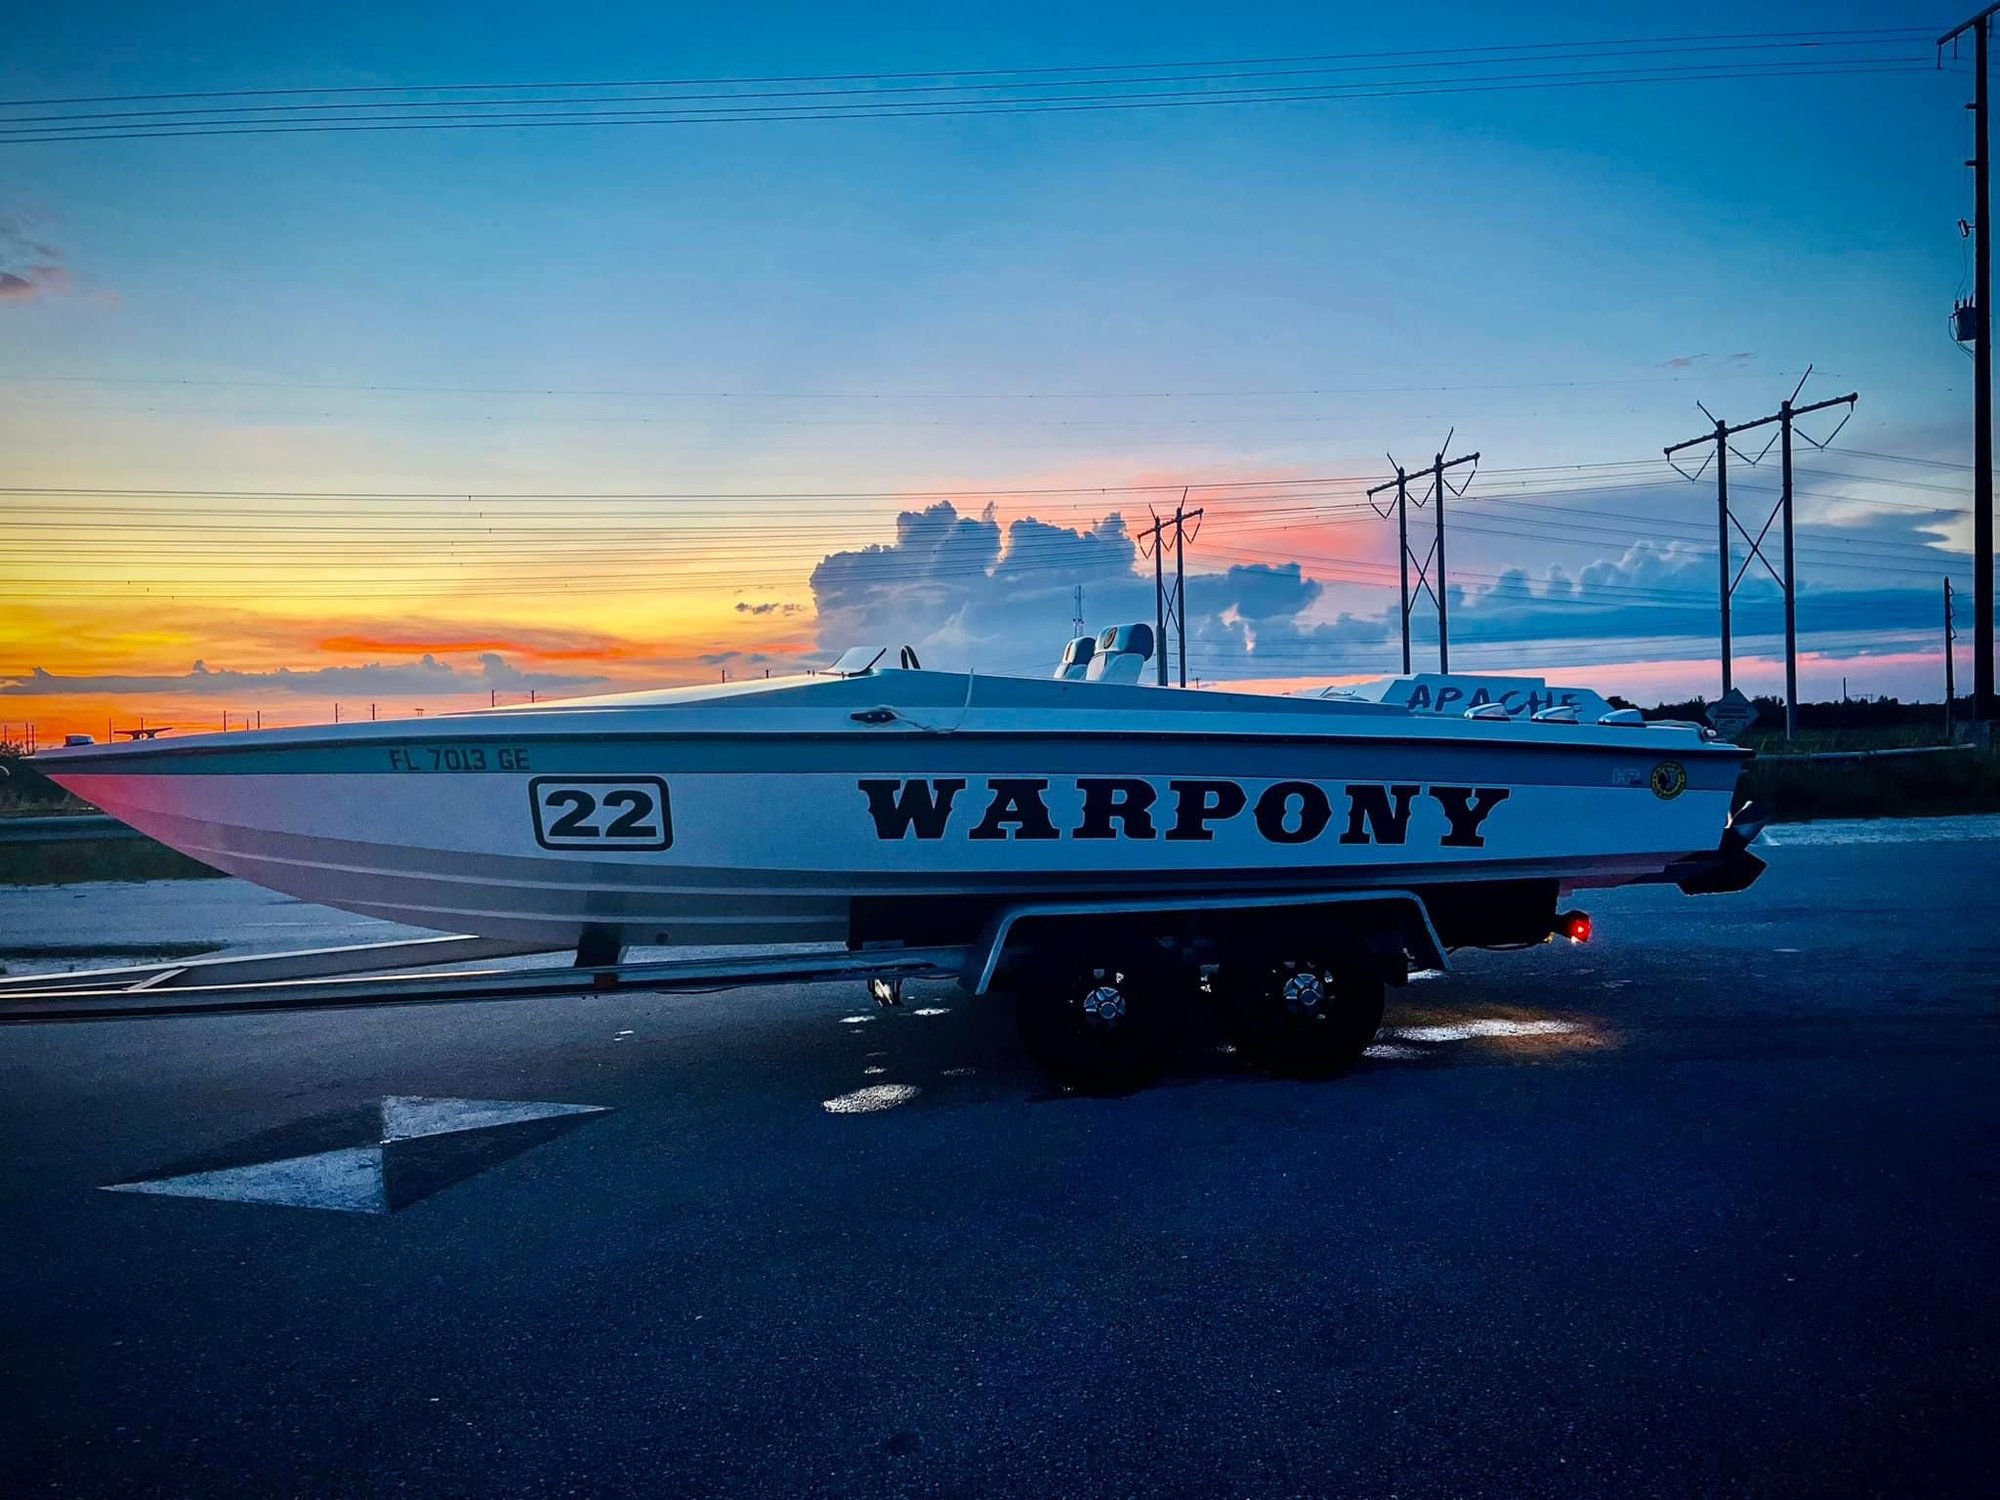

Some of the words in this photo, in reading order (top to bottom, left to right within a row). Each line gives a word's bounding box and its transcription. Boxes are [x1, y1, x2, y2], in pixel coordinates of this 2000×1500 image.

[390, 749, 420, 771] FL
[429, 748, 486, 771] 7013
[499, 748, 530, 770] GE
[545, 789, 657, 837] 22
[858, 777, 1511, 849] WARPONY
